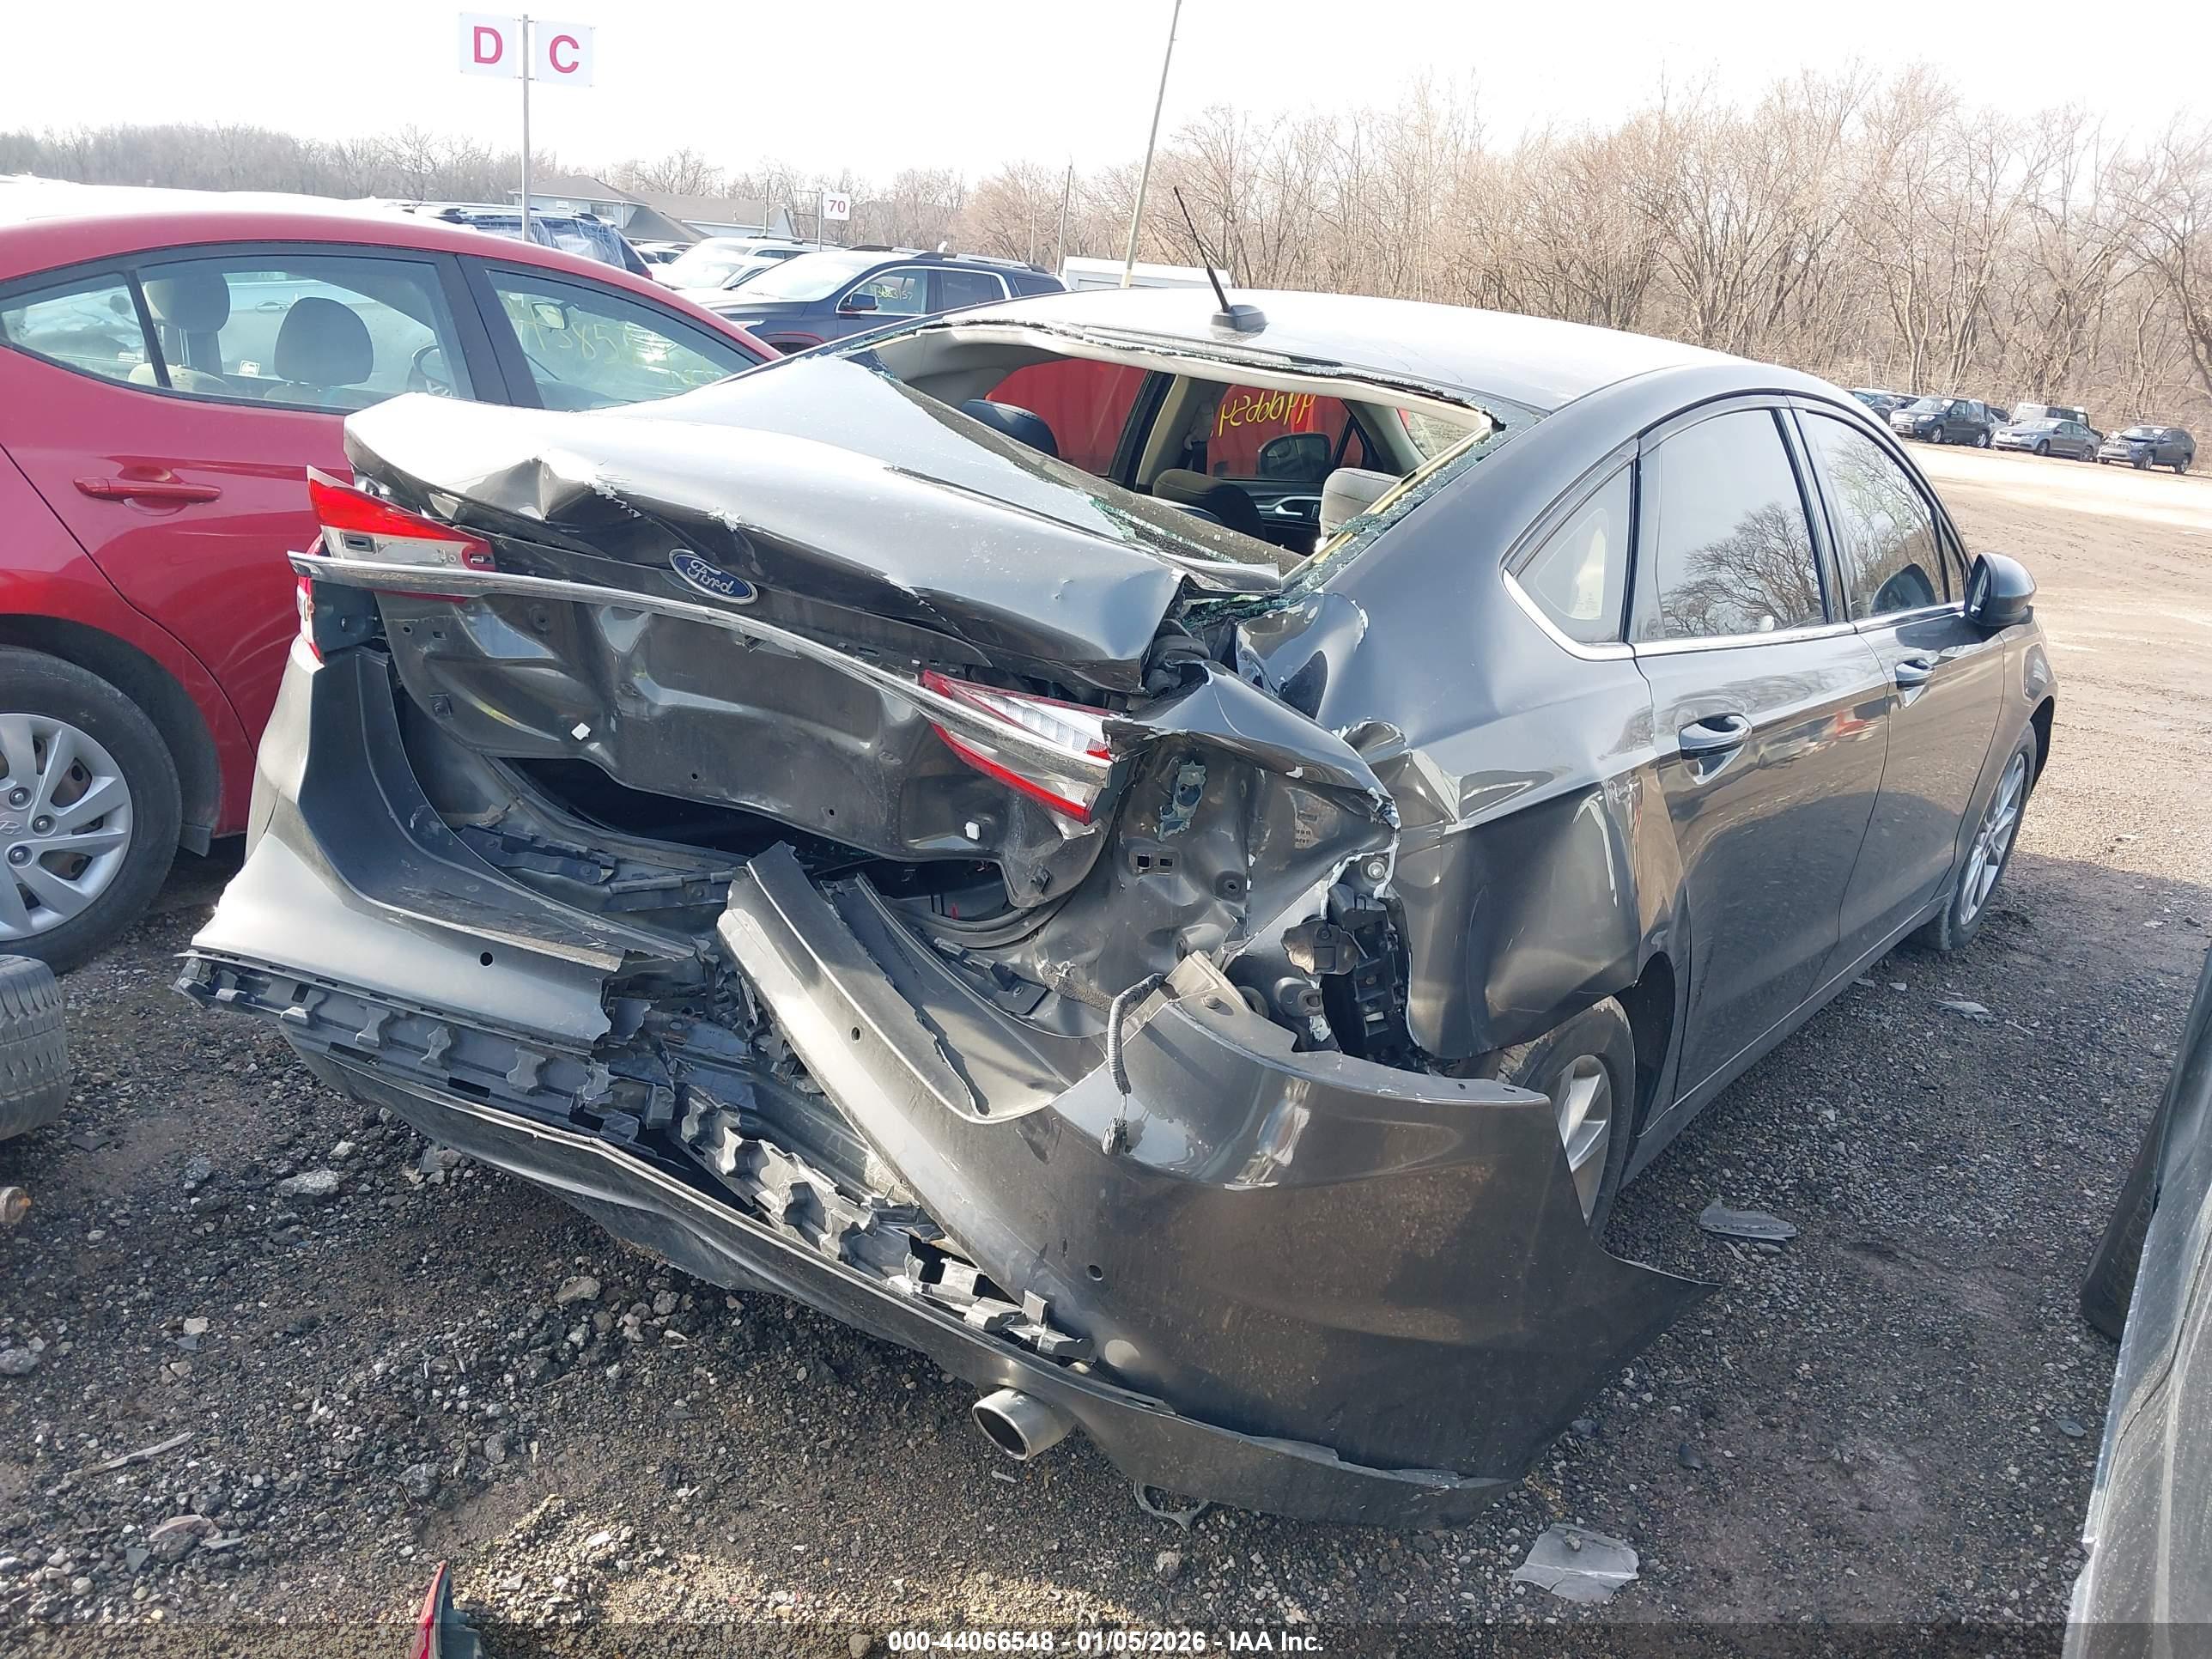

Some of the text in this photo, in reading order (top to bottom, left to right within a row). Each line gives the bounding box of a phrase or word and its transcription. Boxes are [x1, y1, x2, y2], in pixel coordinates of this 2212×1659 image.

[474, 26, 503, 64] D
[549, 34, 580, 74] C
[828, 199, 846, 213] 70
[686, 559, 734, 594] Ford
